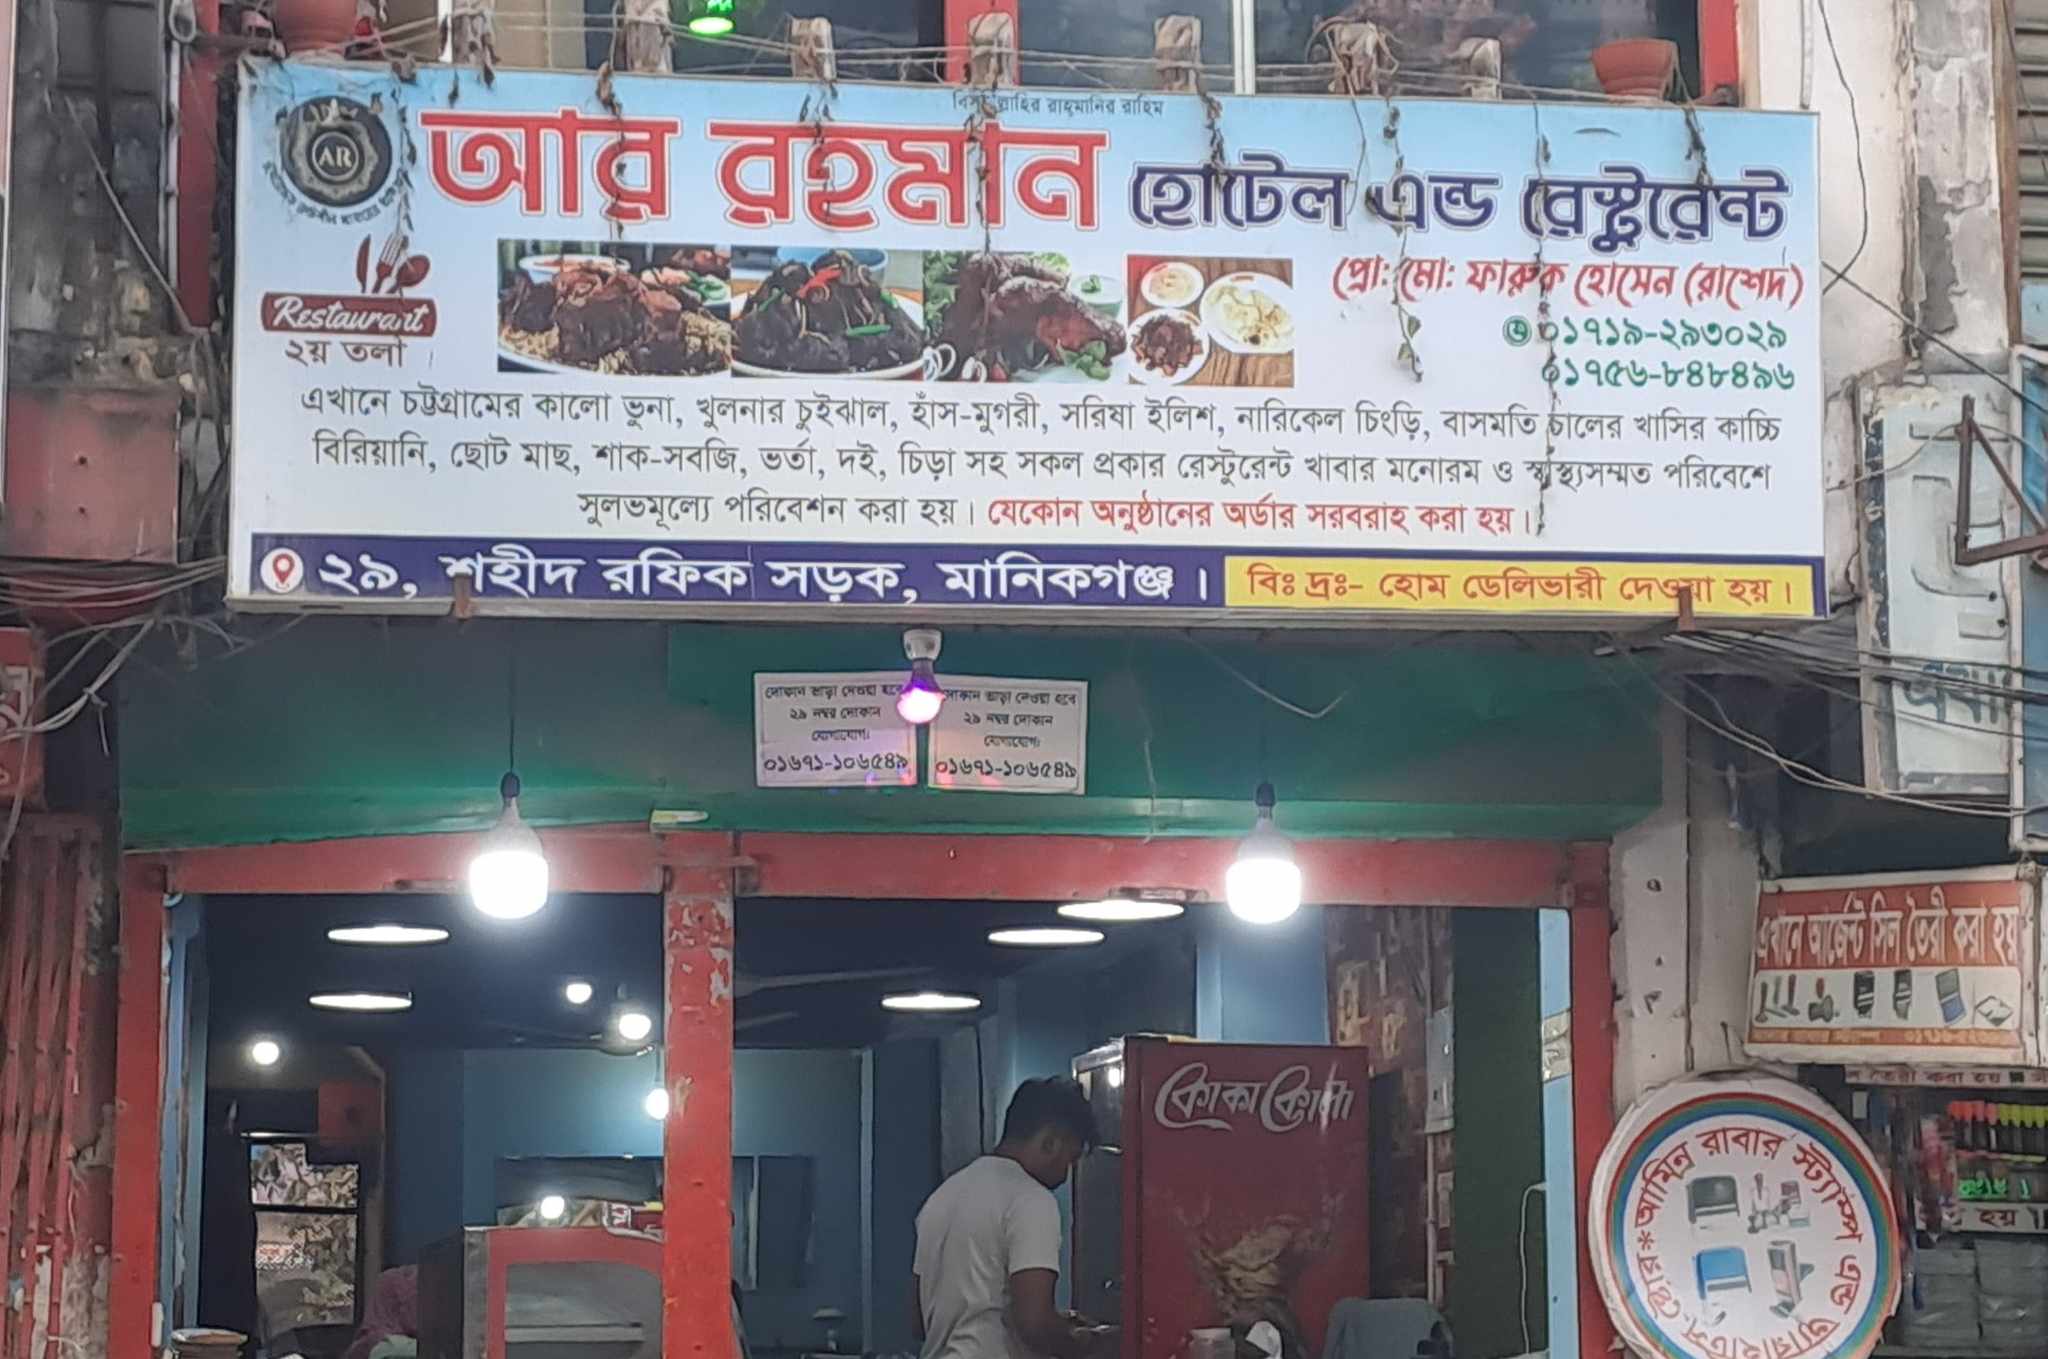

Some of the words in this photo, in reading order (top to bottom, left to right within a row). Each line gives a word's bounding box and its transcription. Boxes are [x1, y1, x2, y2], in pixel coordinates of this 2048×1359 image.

[318, 146, 353, 168] AR
[419, 107, 682, 222] আর
[706, 120, 1109, 231] রহমান
[1133, 153, 1347, 228] হোটেল
[1372, 174, 1500, 230] এন্ড
[1466, 259, 1569, 297] ফারুক
[1574, 263, 1679, 308] হোসেন
[273, 297, 425, 333] Restaurant
[1540, 317, 1787, 351] ০১৭১৯-২৯৩০২৯
[284, 339, 331, 366] ২য়
[340, 338, 407, 368] তলা
[1542, 359, 1795, 390] ০১৭৫৬-৮৪৮৪৯৬
[301, 385, 391, 415] এখানে
[401, 381, 523, 419] চট্টগ্রামের
[534, 389, 611, 422] কালো
[621, 393, 683, 428] ভুনা,
[696, 395, 785, 433] খুলনার
[795, 391, 898, 432] চুইঝাল,
[908, 390, 1048, 436] হাঁস-মুগরী,
[1062, 394, 1135, 431] সরিষা
[1144, 394, 1225, 438] ইলিশ,
[1234, 398, 1345, 433] নারিকেল
[1355, 400, 1430, 441] চিংড়ি,
[1440, 403, 1539, 438] বাসমতি
[1547, 411, 1623, 441] চালের
[1634, 407, 1706, 442] খাসির
[1715, 409, 1782, 442] কাচ্চি
[312, 428, 436, 474] বিরিয়ানি,
[451, 433, 511, 467] ছোট
[520, 440, 581, 475] মাছ,
[593, 437, 747, 479] শাক-সবজি,
[759, 438, 825, 480] ভর্তা,
[836, 441, 886, 481] দই,
[899, 441, 955, 481] চিড়া
[965, 450, 1008, 478] সহ
[1018, 450, 1084, 479] সকল
[1094, 451, 1165, 479] প্রকার
[1177, 446, 1294, 486] রেস্টুরেন্ট
[1305, 452, 1376, 482] খাবার
[1385, 457, 1481, 485] মনোরম
[1493, 464, 1513, 483] ও
[1664, 454, 1771, 490] পরিবেশে
[578, 493, 714, 530] সুলভমূল্যে
[725, 487, 847, 525] পরিবেশন
[855, 497, 908, 525] করা
[917, 499, 958, 527] হয়
[988, 497, 1082, 527] যেকোন
[1090, 489, 1214, 534] অনুষ্ঠানের
[1223, 492, 1298, 530] অর্ডার
[1305, 500, 1411, 535] সরবরাহ
[1416, 504, 1467, 535] করা
[1475, 506, 1514, 535] হয়
[318, 552, 418, 600] ২৯,
[438, 544, 585, 598] শহীদ
[597, 547, 753, 597] রফিক
[765, 559, 918, 605] সড়ক,
[936, 550, 1175, 600] মানিকগঞ্জ
[1379, 571, 1451, 601] হোম
[1463, 565, 1604, 604] ডেলিভারী
[1619, 575, 1714, 604] দেওয়া
[1725, 579, 1772, 607] হয়
[841, 706, 881, 719] দোকান
[1013, 714, 1053, 728] দোকান
[1952, 900, 1988, 962] করা
[1990, 905, 2020, 967] হয়
[1696, 1127, 1787, 1160] রাবার
[1830, 1255, 1862, 1315] এন্ড
